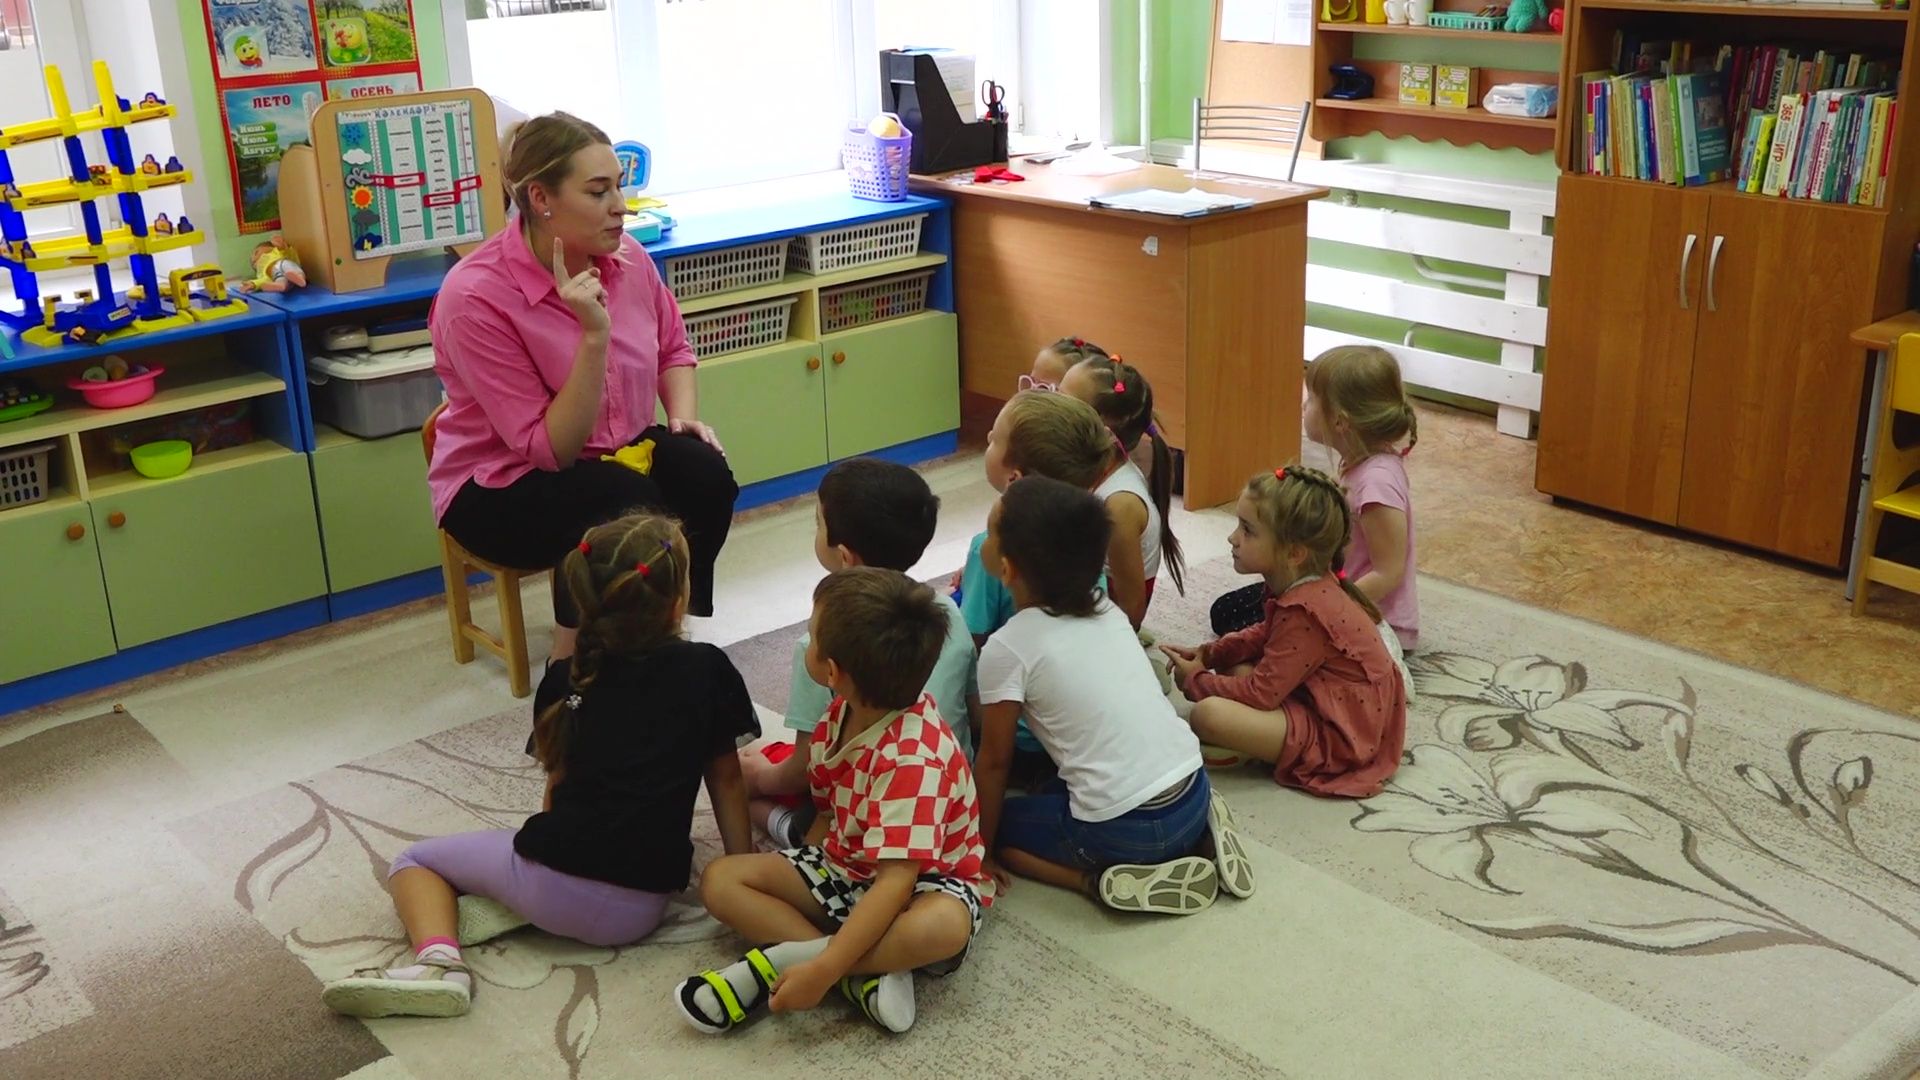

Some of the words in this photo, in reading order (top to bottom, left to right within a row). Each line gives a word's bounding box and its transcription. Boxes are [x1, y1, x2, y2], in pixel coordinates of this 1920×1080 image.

[351, 85, 394, 99] ОСЕНЬ
[252, 93, 292, 108] ЛЕТО
[1780, 103, 1793, 121] 365
